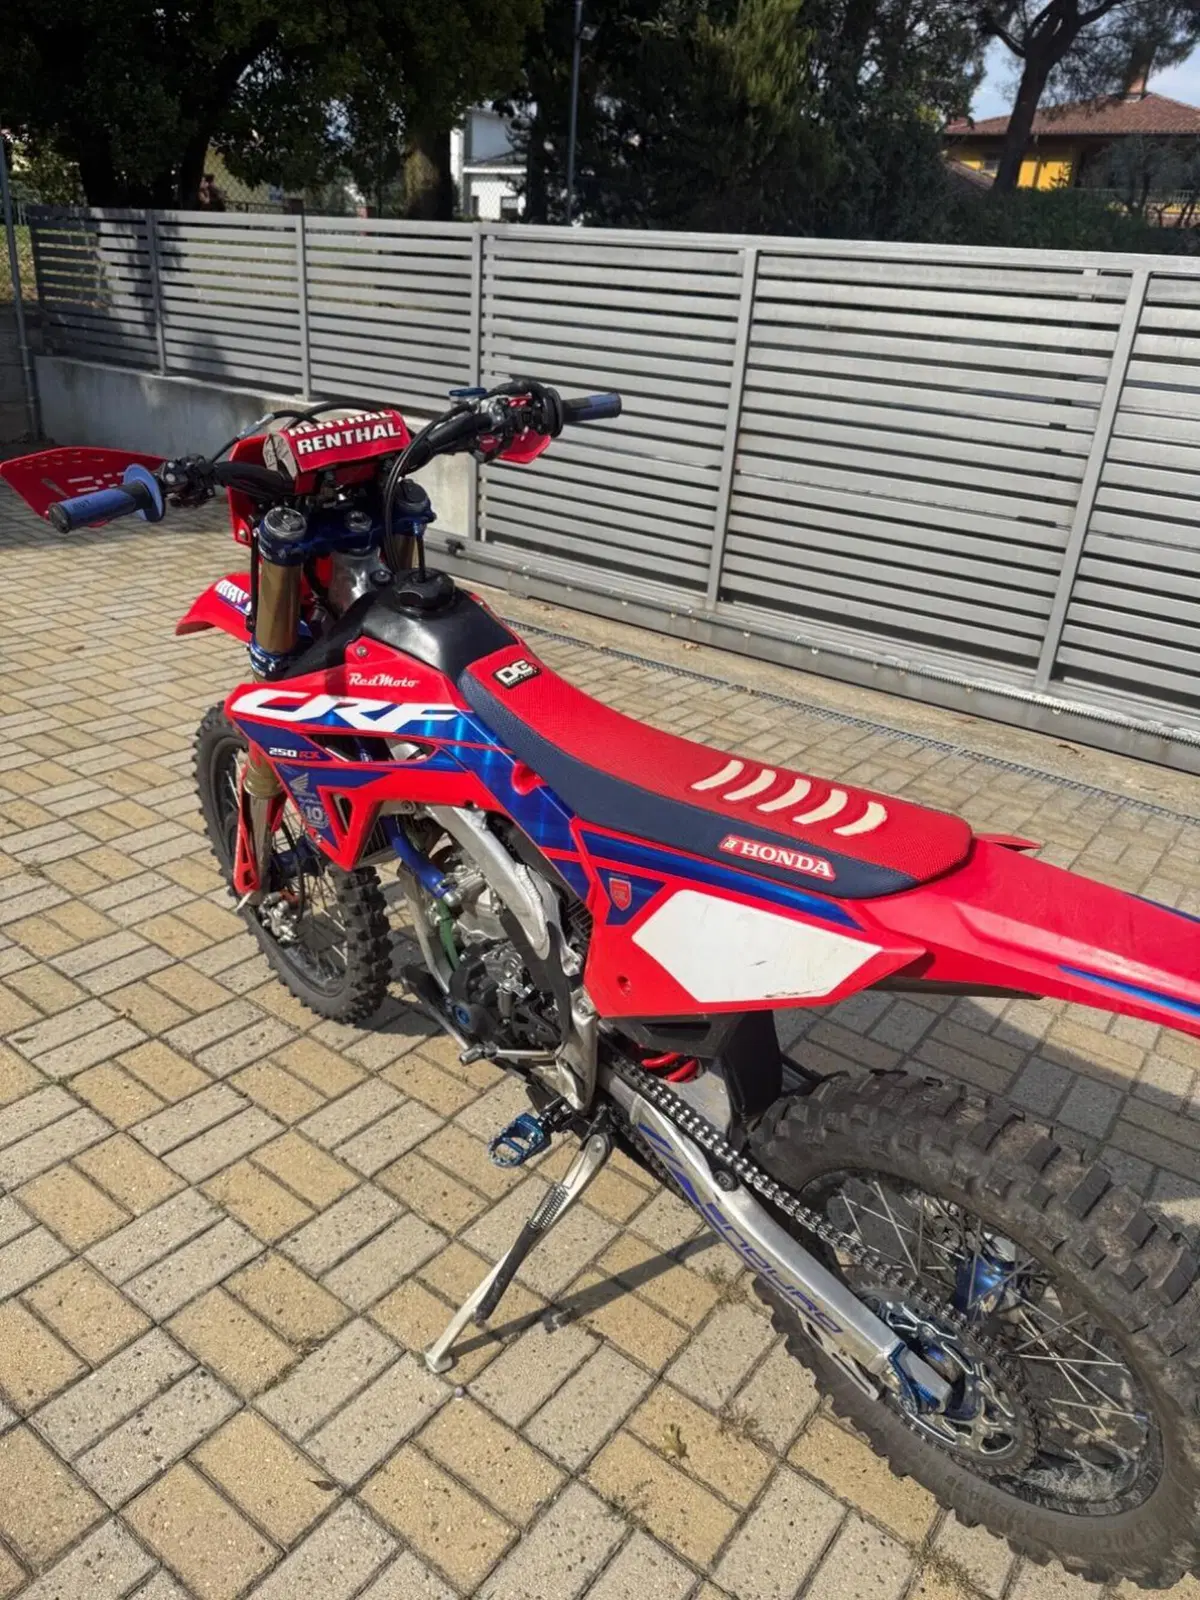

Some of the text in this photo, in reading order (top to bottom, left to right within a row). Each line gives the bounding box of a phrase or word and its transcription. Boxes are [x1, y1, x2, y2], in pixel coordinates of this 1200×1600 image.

[296, 423, 401, 455] RENTHAL
[348, 672, 419, 688] RedMoto
[231, 688, 460, 733] CRF
[269, 747, 298, 758] 250
[741, 842, 832, 878] HONDA
